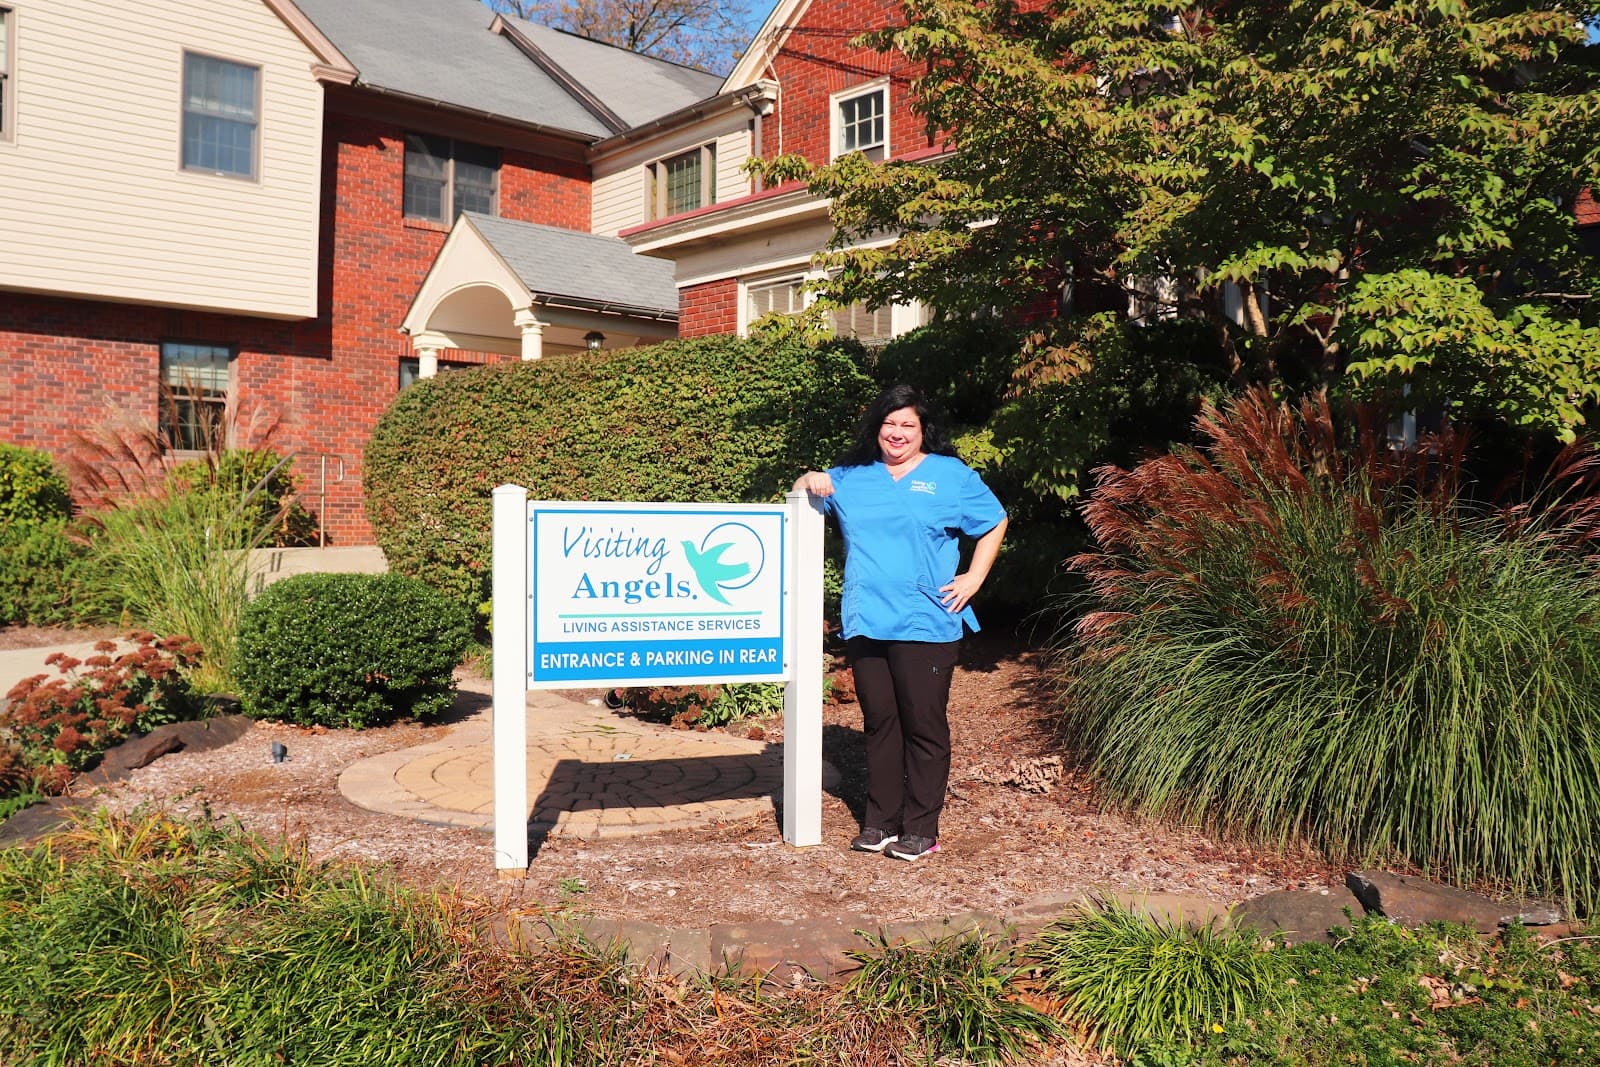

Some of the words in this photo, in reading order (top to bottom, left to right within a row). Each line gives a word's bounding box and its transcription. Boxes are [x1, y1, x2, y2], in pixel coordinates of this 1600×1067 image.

[564, 526, 670, 575] Visiting
[563, 621, 607, 634] LIVING
[611, 620, 694, 633] ASSISTANCE
[698, 619, 761, 631] SERVICES
[541, 652, 625, 669] ENTRANCE
[630, 652, 641, 667] &
[646, 650, 714, 666] PARKING
[719, 649, 735, 664] IN
[740, 648, 777, 663] REAR
